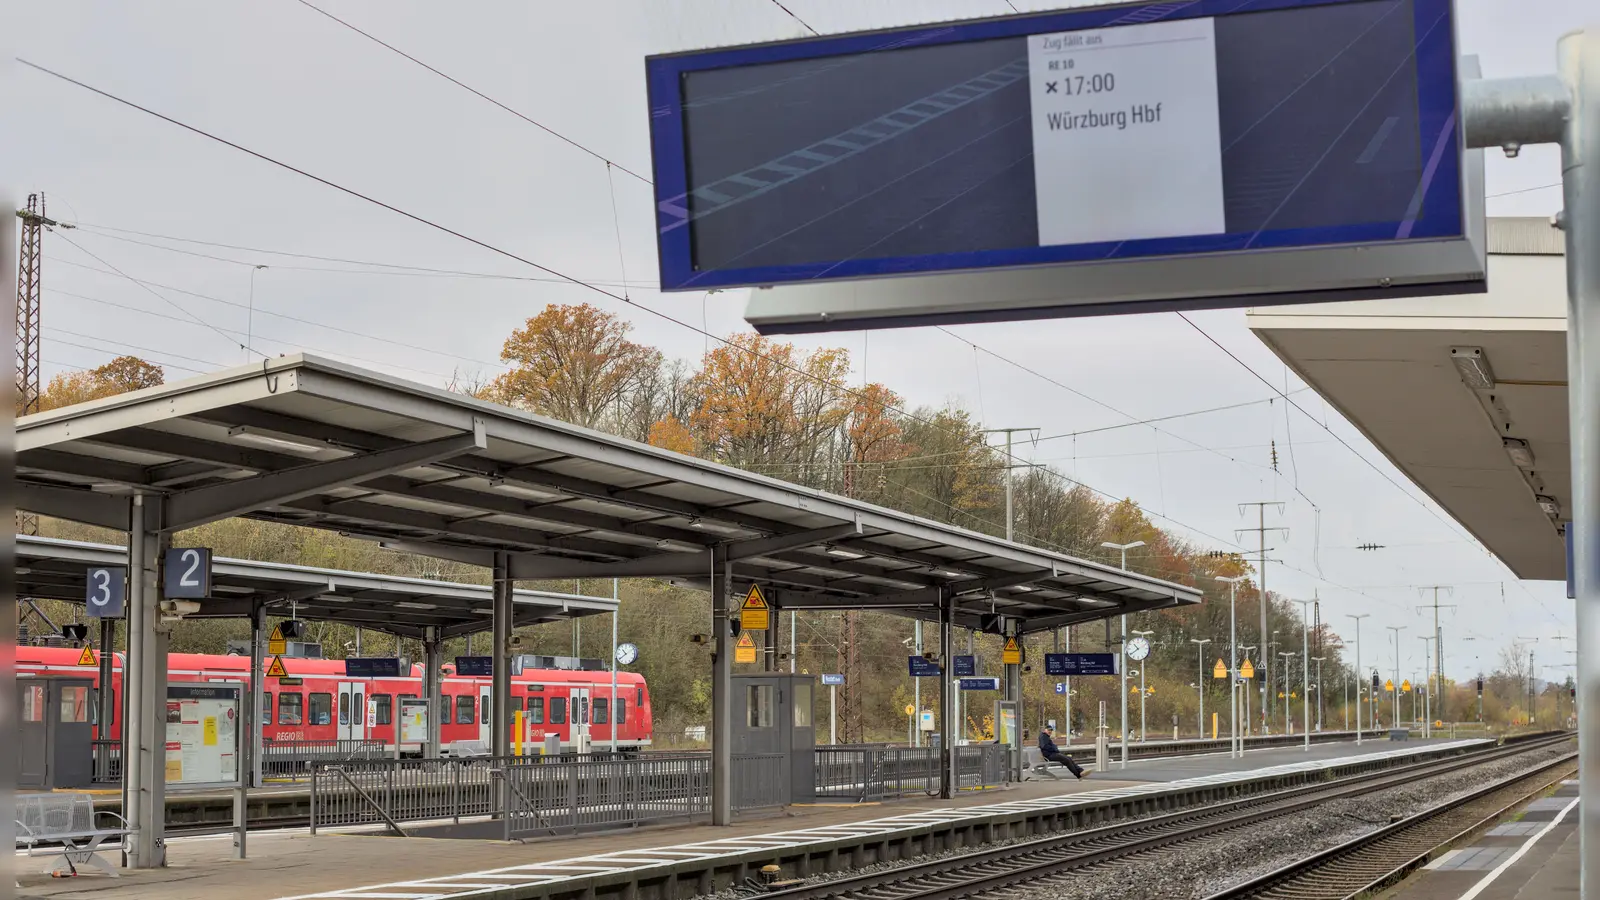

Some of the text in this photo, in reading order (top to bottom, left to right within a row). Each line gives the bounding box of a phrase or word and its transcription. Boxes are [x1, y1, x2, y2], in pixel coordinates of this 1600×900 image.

[1043, 34, 1103, 50] Zug fällt aus
[1048, 59, 1075, 71] RE 10
[1064, 73, 1115, 96] 17:00
[1047, 102, 1162, 131] Würzburg Hbf
[180, 549, 200, 587] 2
[91, 569, 111, 607] 3
[37, 687, 43, 698] 2
[190, 688, 216, 696] Information
[1056, 682, 1063, 692] 5
[276, 731, 296, 741] REGIO
